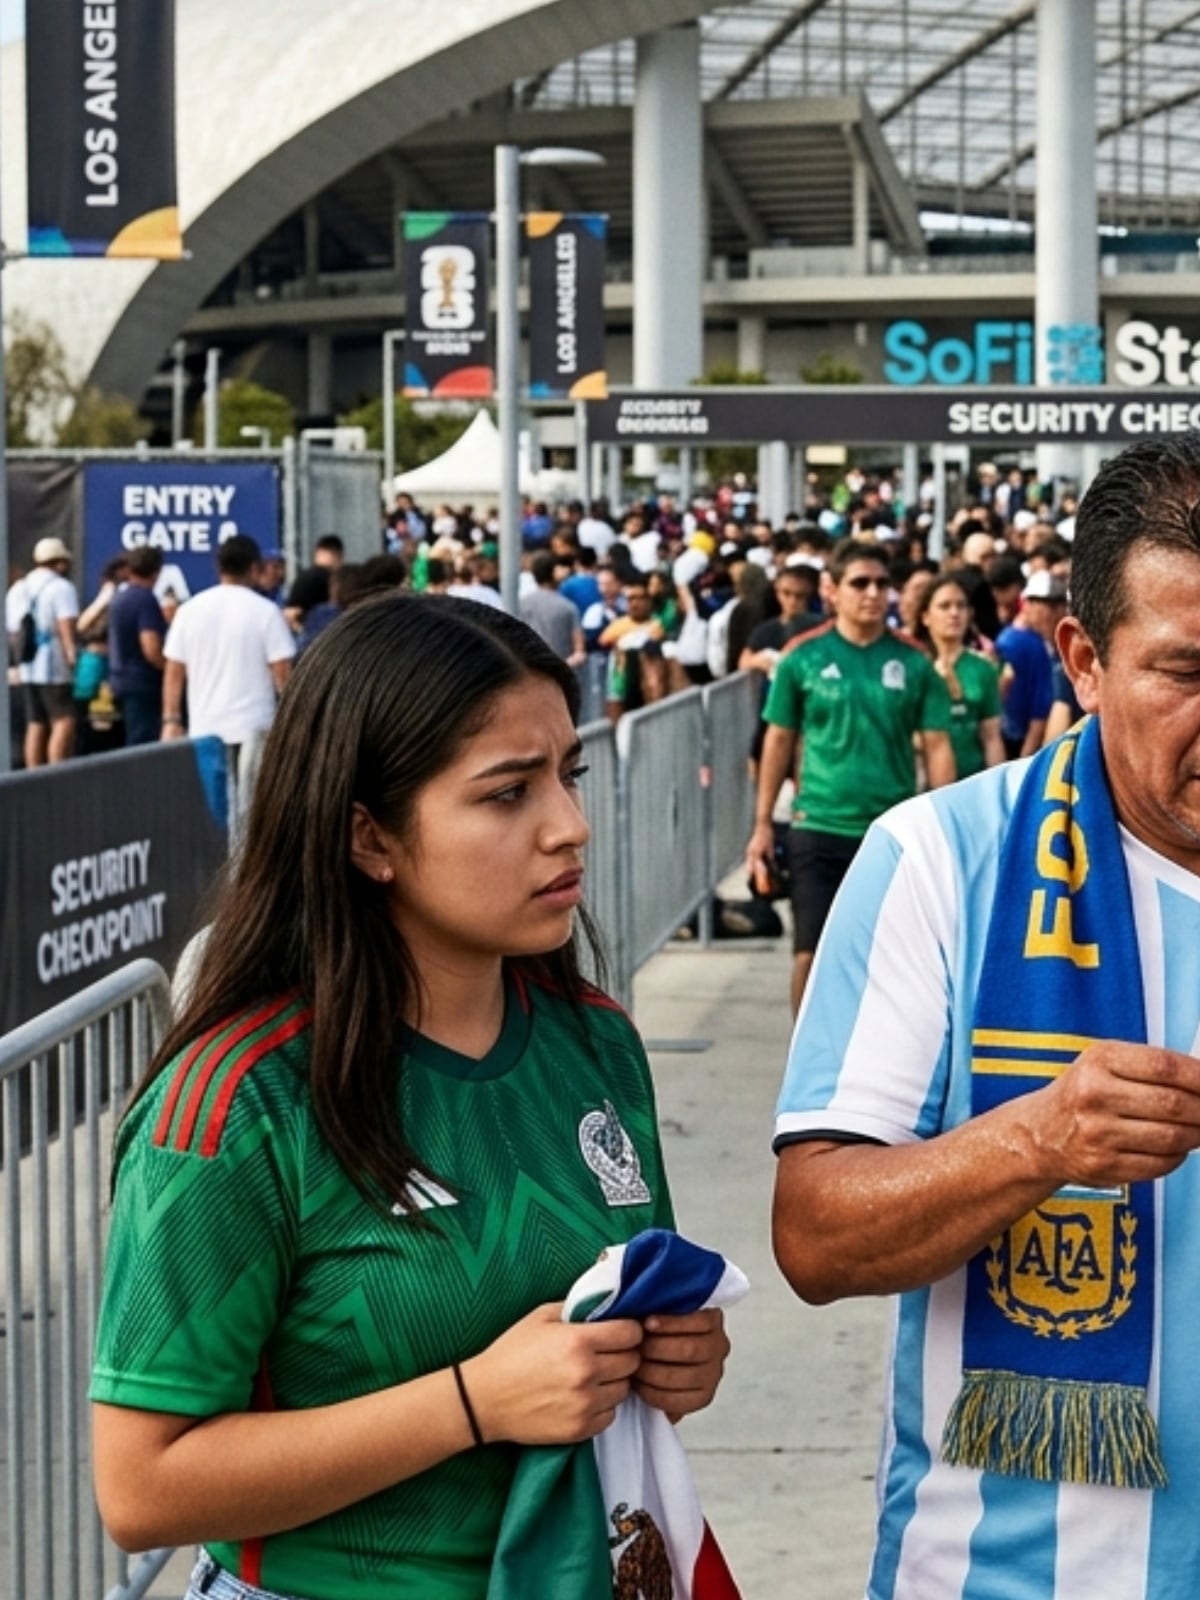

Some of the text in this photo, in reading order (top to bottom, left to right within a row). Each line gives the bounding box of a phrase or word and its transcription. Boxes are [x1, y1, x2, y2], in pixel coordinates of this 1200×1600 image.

[83, 0, 119, 206] LOS ANGE
[884, 322, 1032, 386] SoFi
[948, 403, 1115, 432] SECURITY
[121, 521, 211, 551] GATE
[123, 485, 235, 516] ENTRY
[51, 838, 151, 916] SECURITY
[37, 892, 167, 984] CHECKPOINT
[1015, 1208, 1105, 1295] AFA
